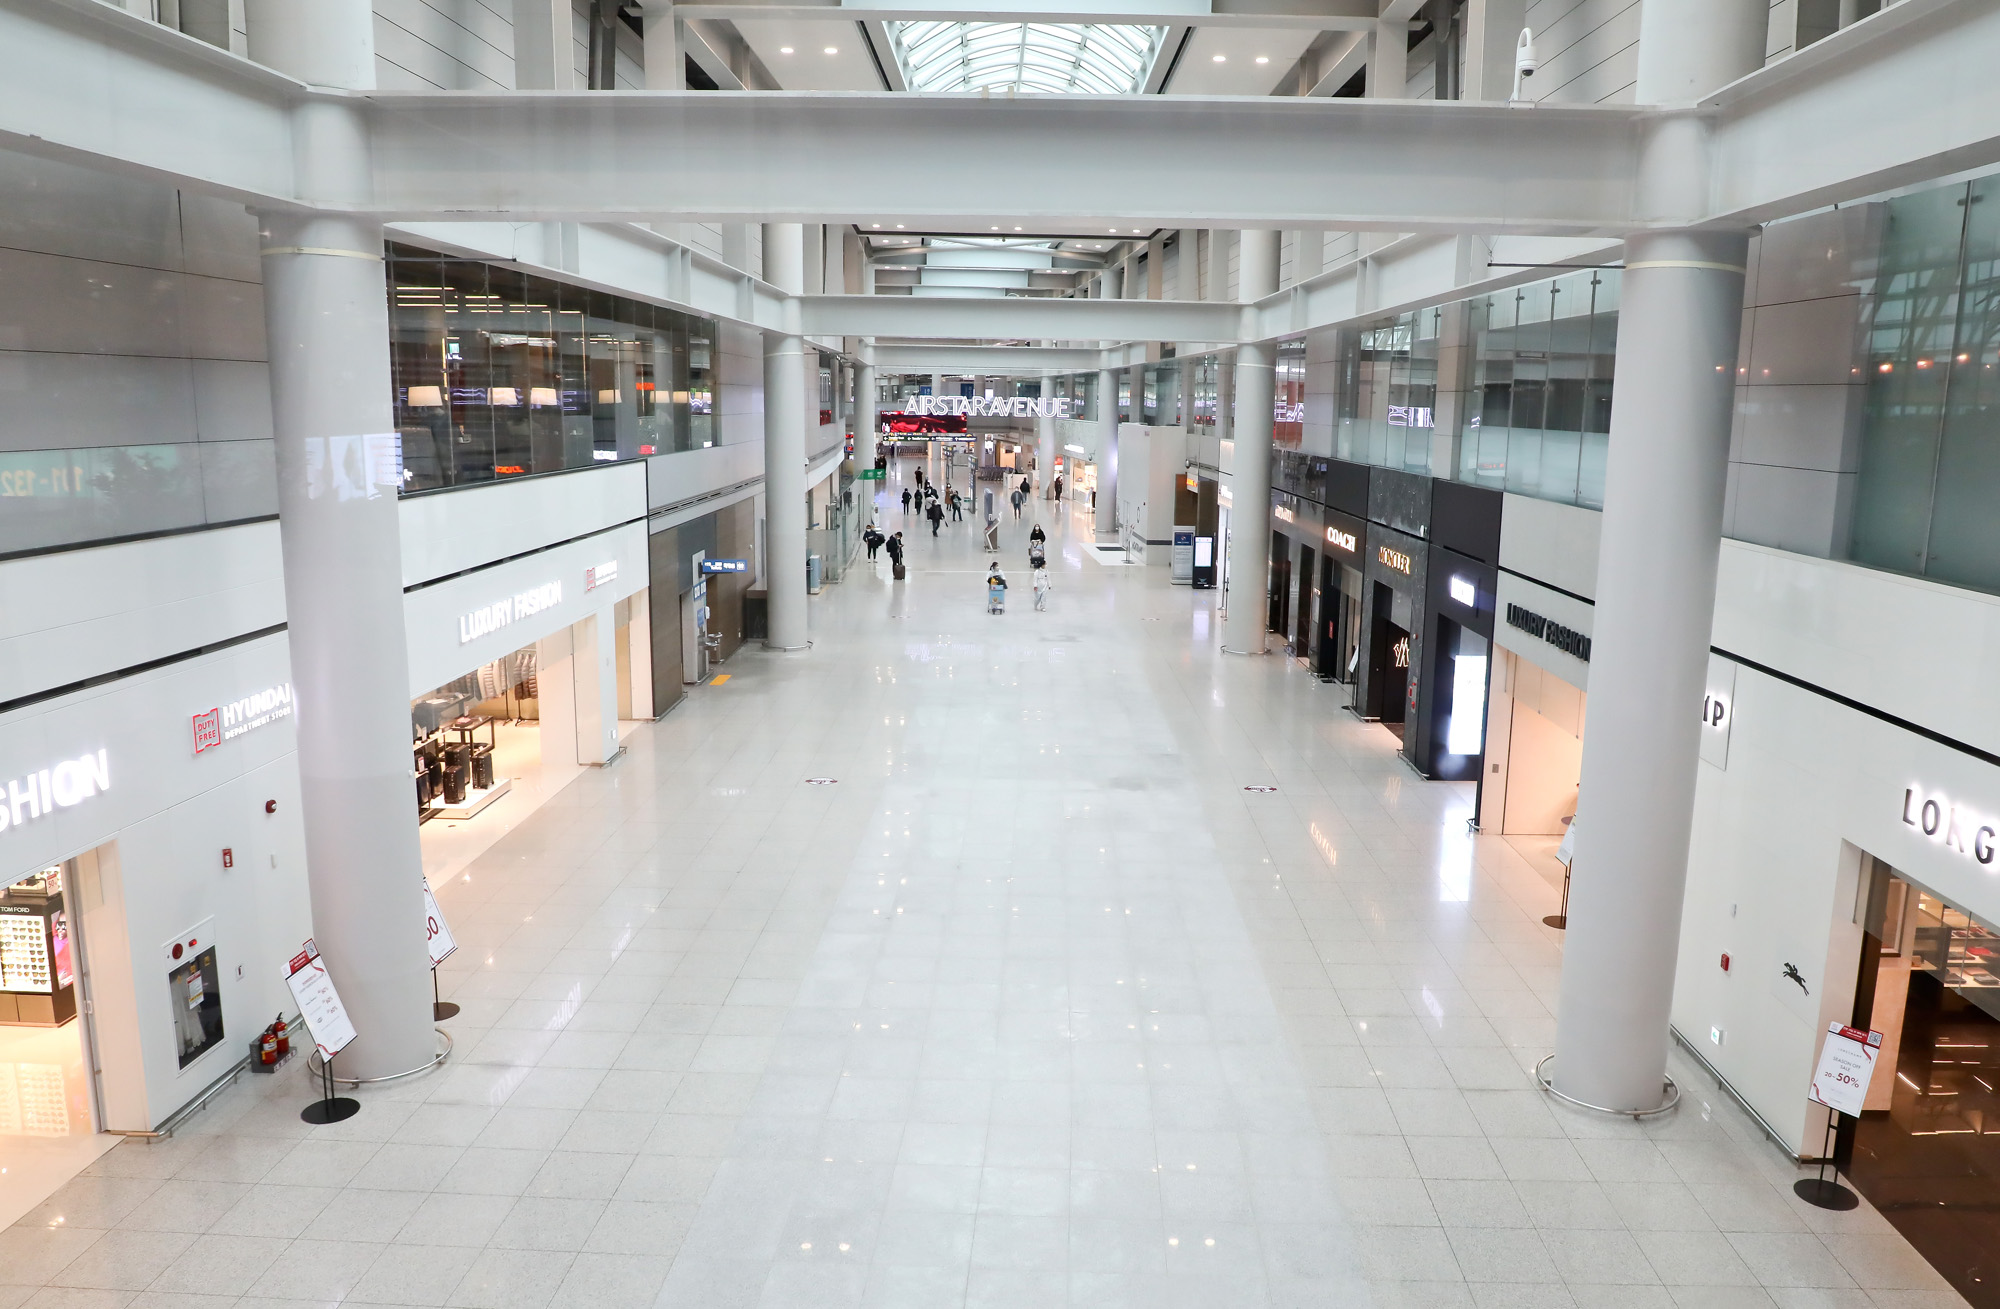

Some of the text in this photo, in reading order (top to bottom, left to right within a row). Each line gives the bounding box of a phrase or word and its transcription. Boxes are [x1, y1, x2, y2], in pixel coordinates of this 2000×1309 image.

[904, 395, 986, 416] AIRSTAR
[988, 396, 1070, 418] AVENUE
[1327, 526, 1356, 553] COACH
[459, 580, 562, 644] LUXURY FASHION
[1506, 602, 1592, 663] LUXURY FASHION
[222, 682, 291, 728] HYUNDAI
[197, 718, 215, 732] DUTY
[224, 706, 291, 740] DEPARTMENT STORE
[198, 729, 216, 743] FREE
[1833, 1057, 1851, 1066] SEASON
[1840, 1064, 1851, 1072] SALE
